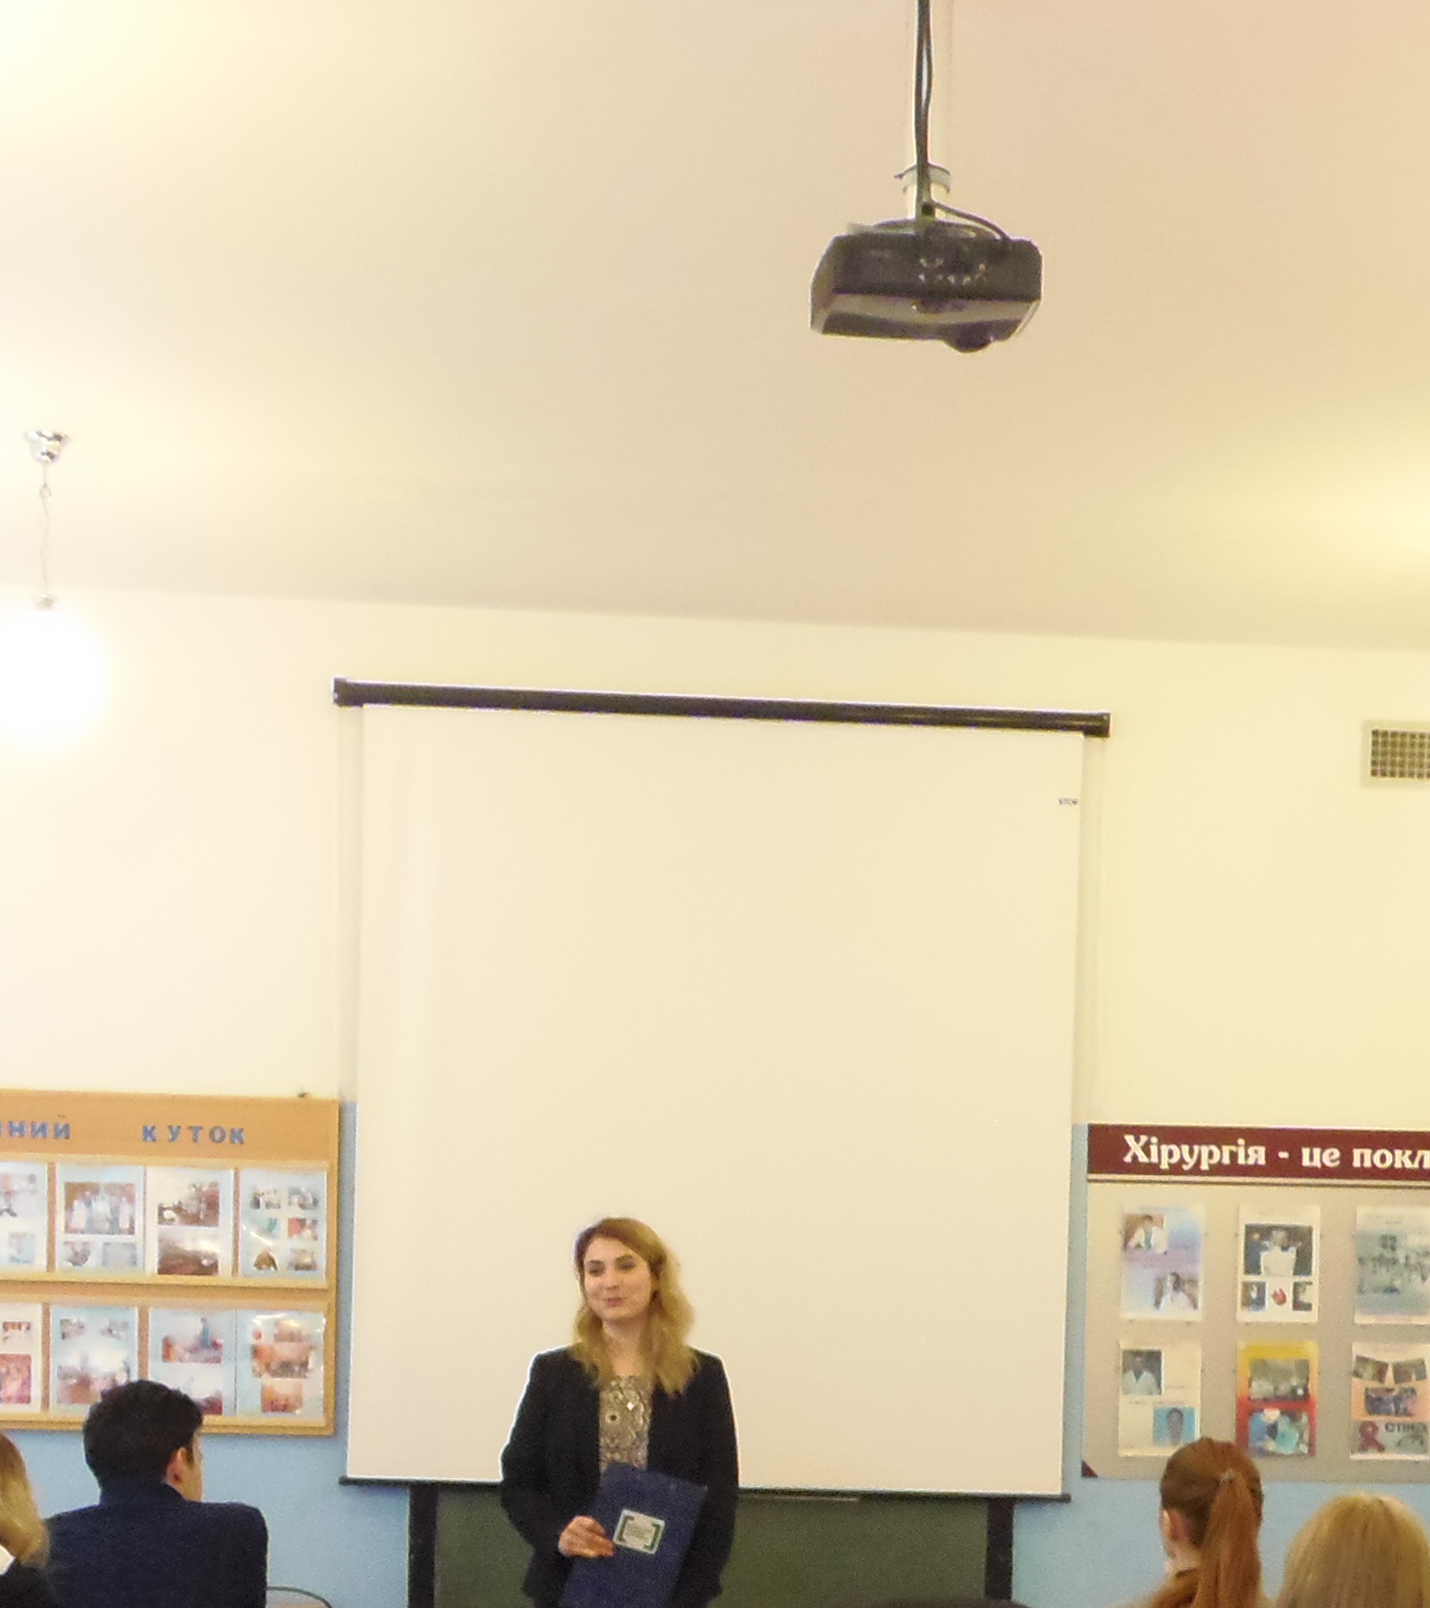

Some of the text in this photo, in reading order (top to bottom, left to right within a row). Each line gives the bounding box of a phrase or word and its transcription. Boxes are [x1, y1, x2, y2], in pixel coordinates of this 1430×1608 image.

[142, 1125, 245, 1145] КУТОК
[1123, 1134, 1267, 1171] Хірургія
[1301, 1147, 1341, 1168] це
